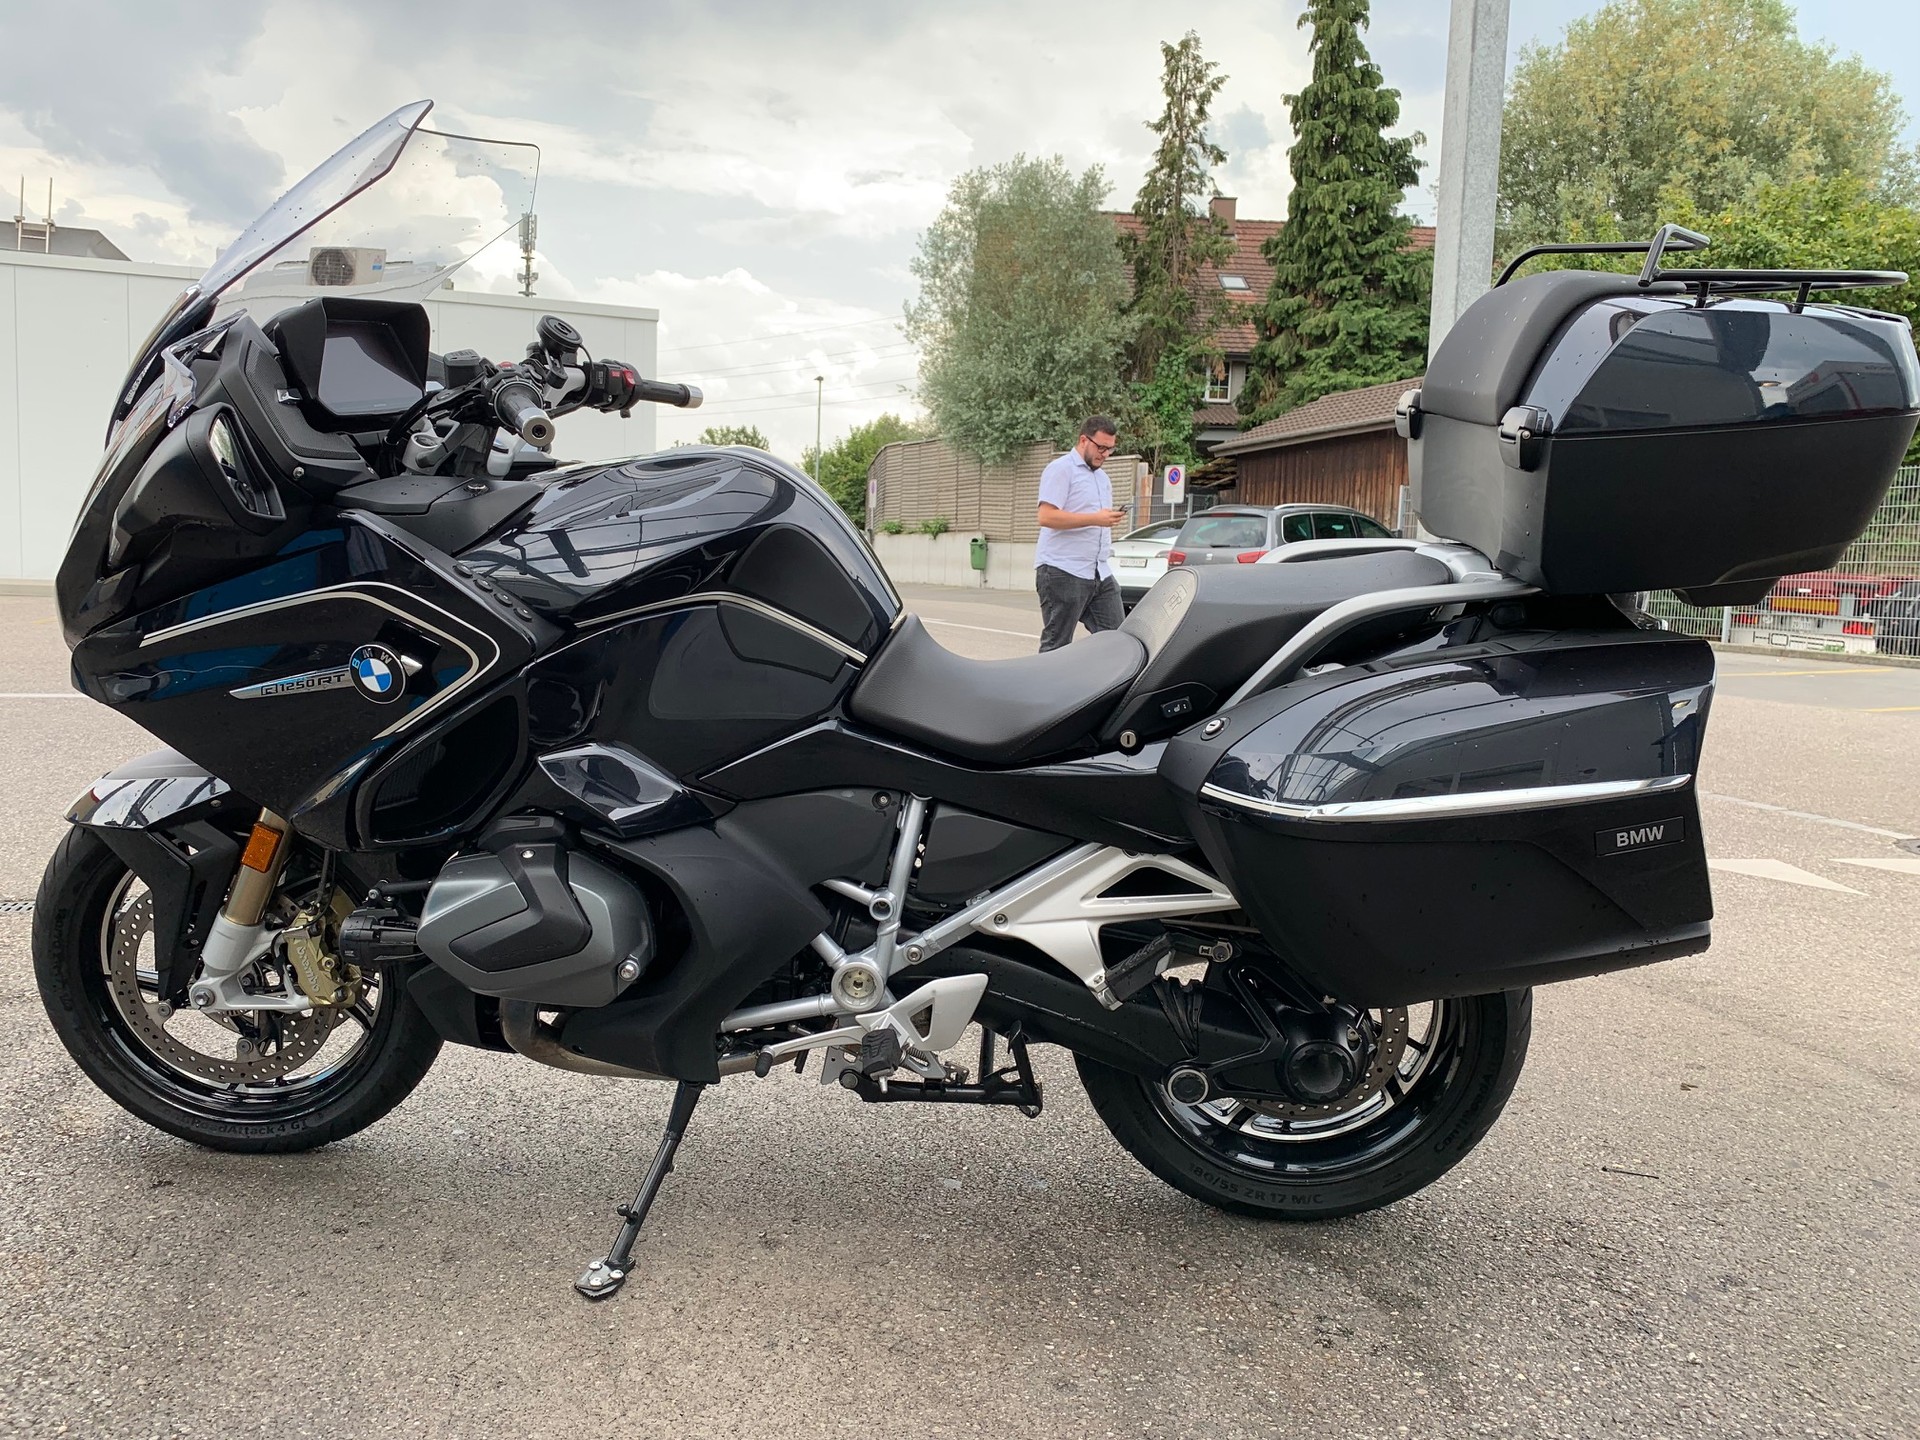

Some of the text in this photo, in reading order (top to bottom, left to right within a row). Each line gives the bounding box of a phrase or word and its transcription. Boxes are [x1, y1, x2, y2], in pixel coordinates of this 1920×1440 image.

[351, 648, 392, 669] BMW
[1616, 825, 1664, 847] BMW
[297, 946, 320, 993] brembo
[278, 1123, 286, 1133] 4
[1244, 1187, 1266, 1201] ZR
[1270, 1192, 1288, 1204] 17
[1291, 1193, 1324, 1205] M/C
